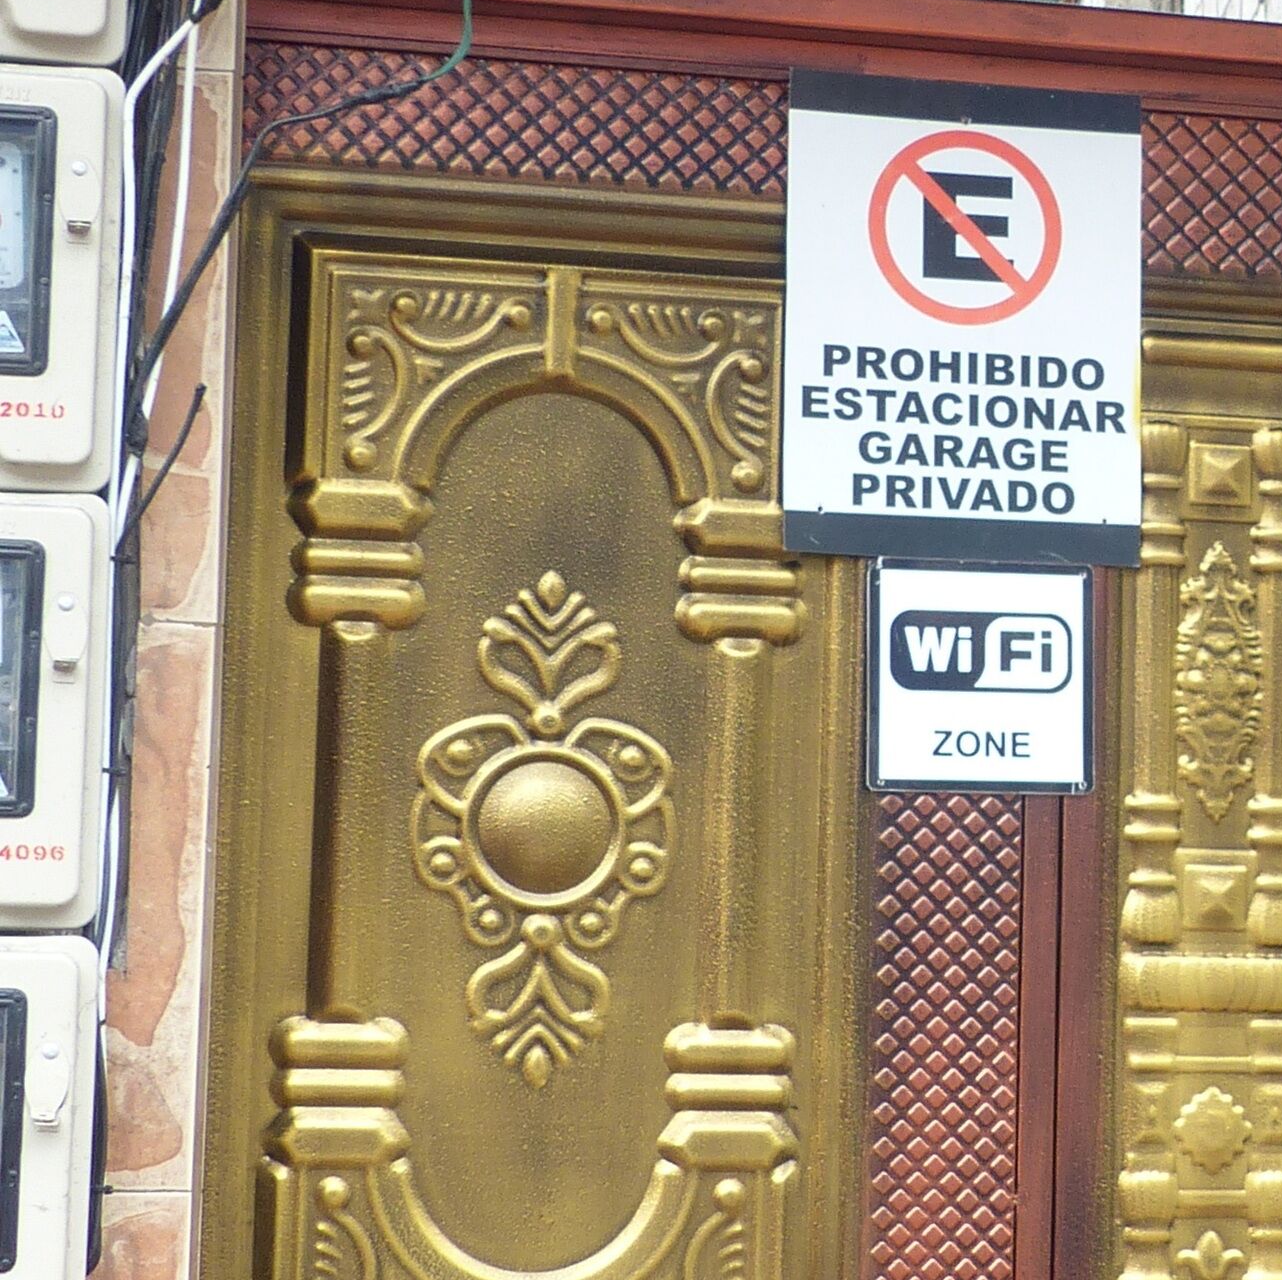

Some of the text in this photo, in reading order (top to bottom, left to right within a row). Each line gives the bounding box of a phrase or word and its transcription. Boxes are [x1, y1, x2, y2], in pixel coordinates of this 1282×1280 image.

[822, 344, 1105, 390] PROHIBIDO
[801, 386, 1126, 433] ESTACIONAR
[858, 431, 1069, 472] GARAGE
[852, 474, 1075, 515] PRIVADO
[932, 730, 1031, 758] ZONE
